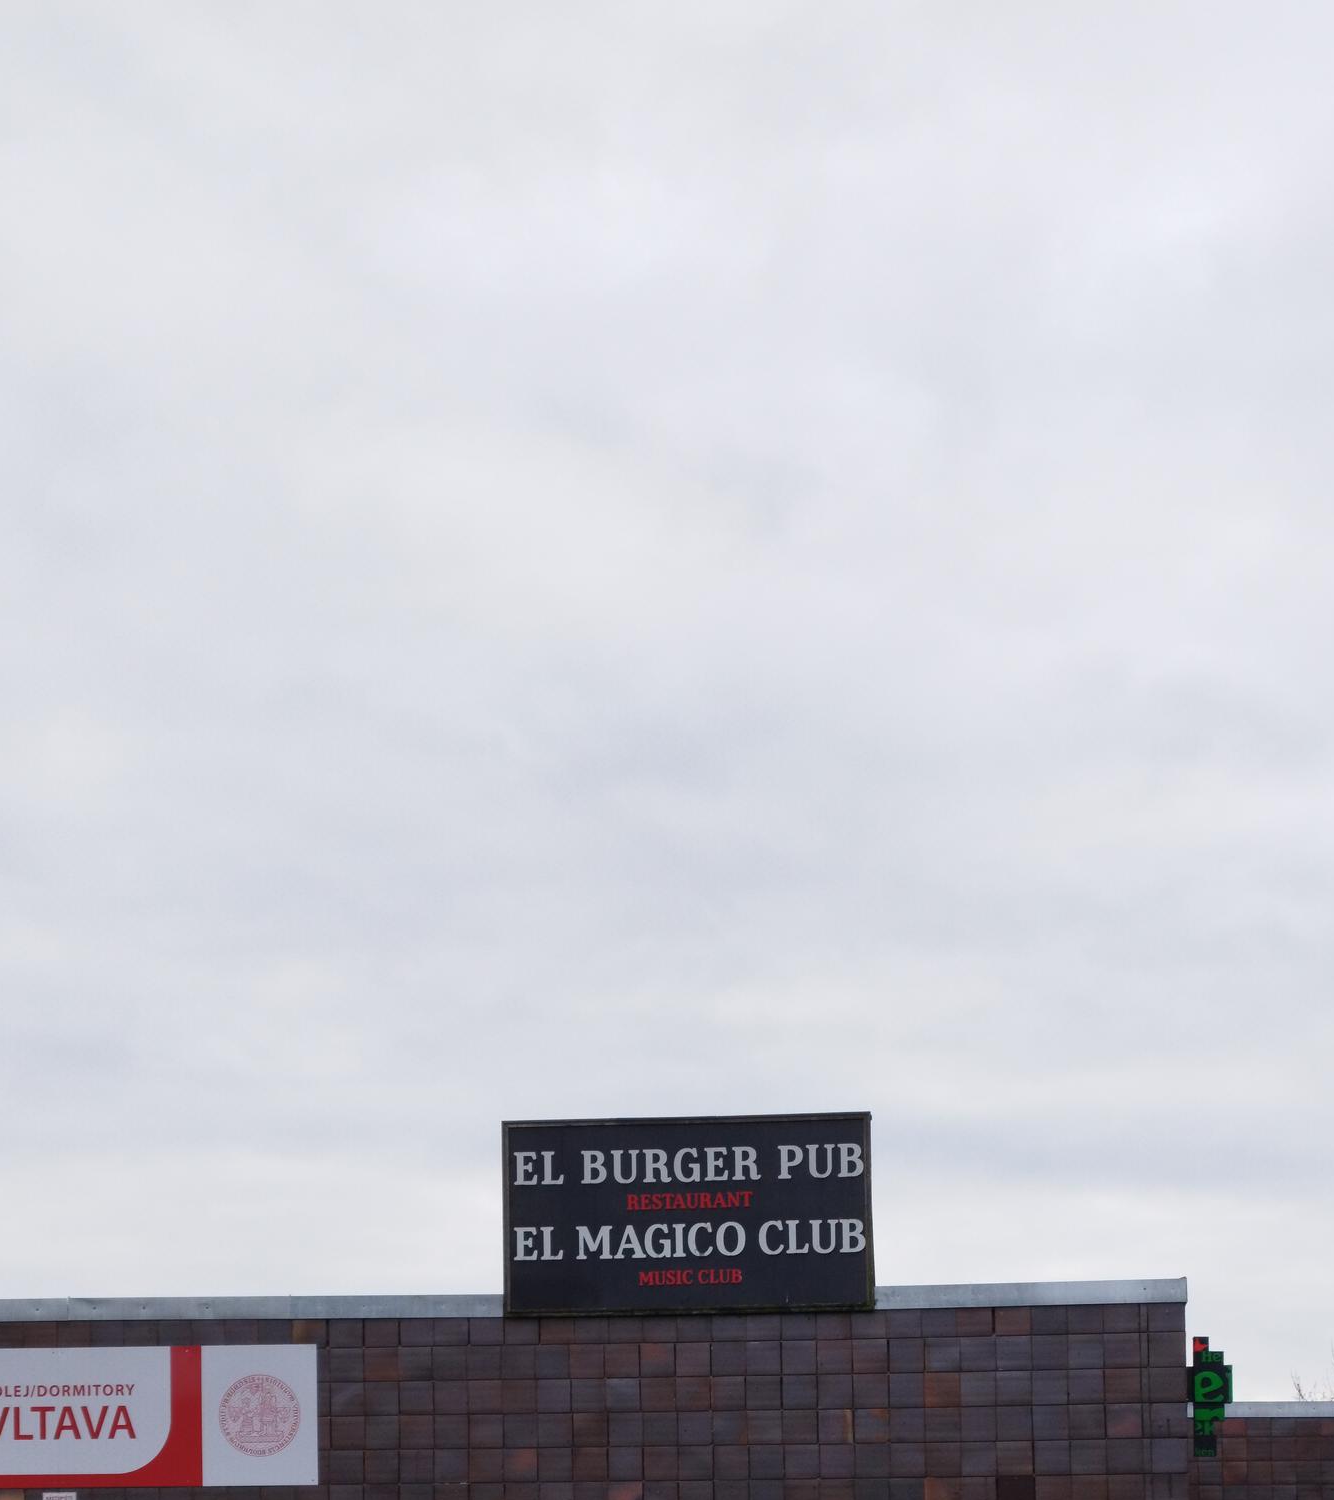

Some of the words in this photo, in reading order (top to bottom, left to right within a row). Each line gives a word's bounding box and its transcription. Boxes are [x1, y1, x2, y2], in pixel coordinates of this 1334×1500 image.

[513, 1150, 565, 1187] EL
[580, 1145, 762, 1185] BURGER
[776, 1142, 865, 1181] PUB
[626, 1190, 754, 1212] RESTAURANT
[513, 1226, 564, 1262] EL
[575, 1221, 747, 1261] MAGICO
[757, 1218, 867, 1256] CLUB
[637, 1270, 693, 1288] MUSIC
[697, 1268, 744, 1286] CLUB
